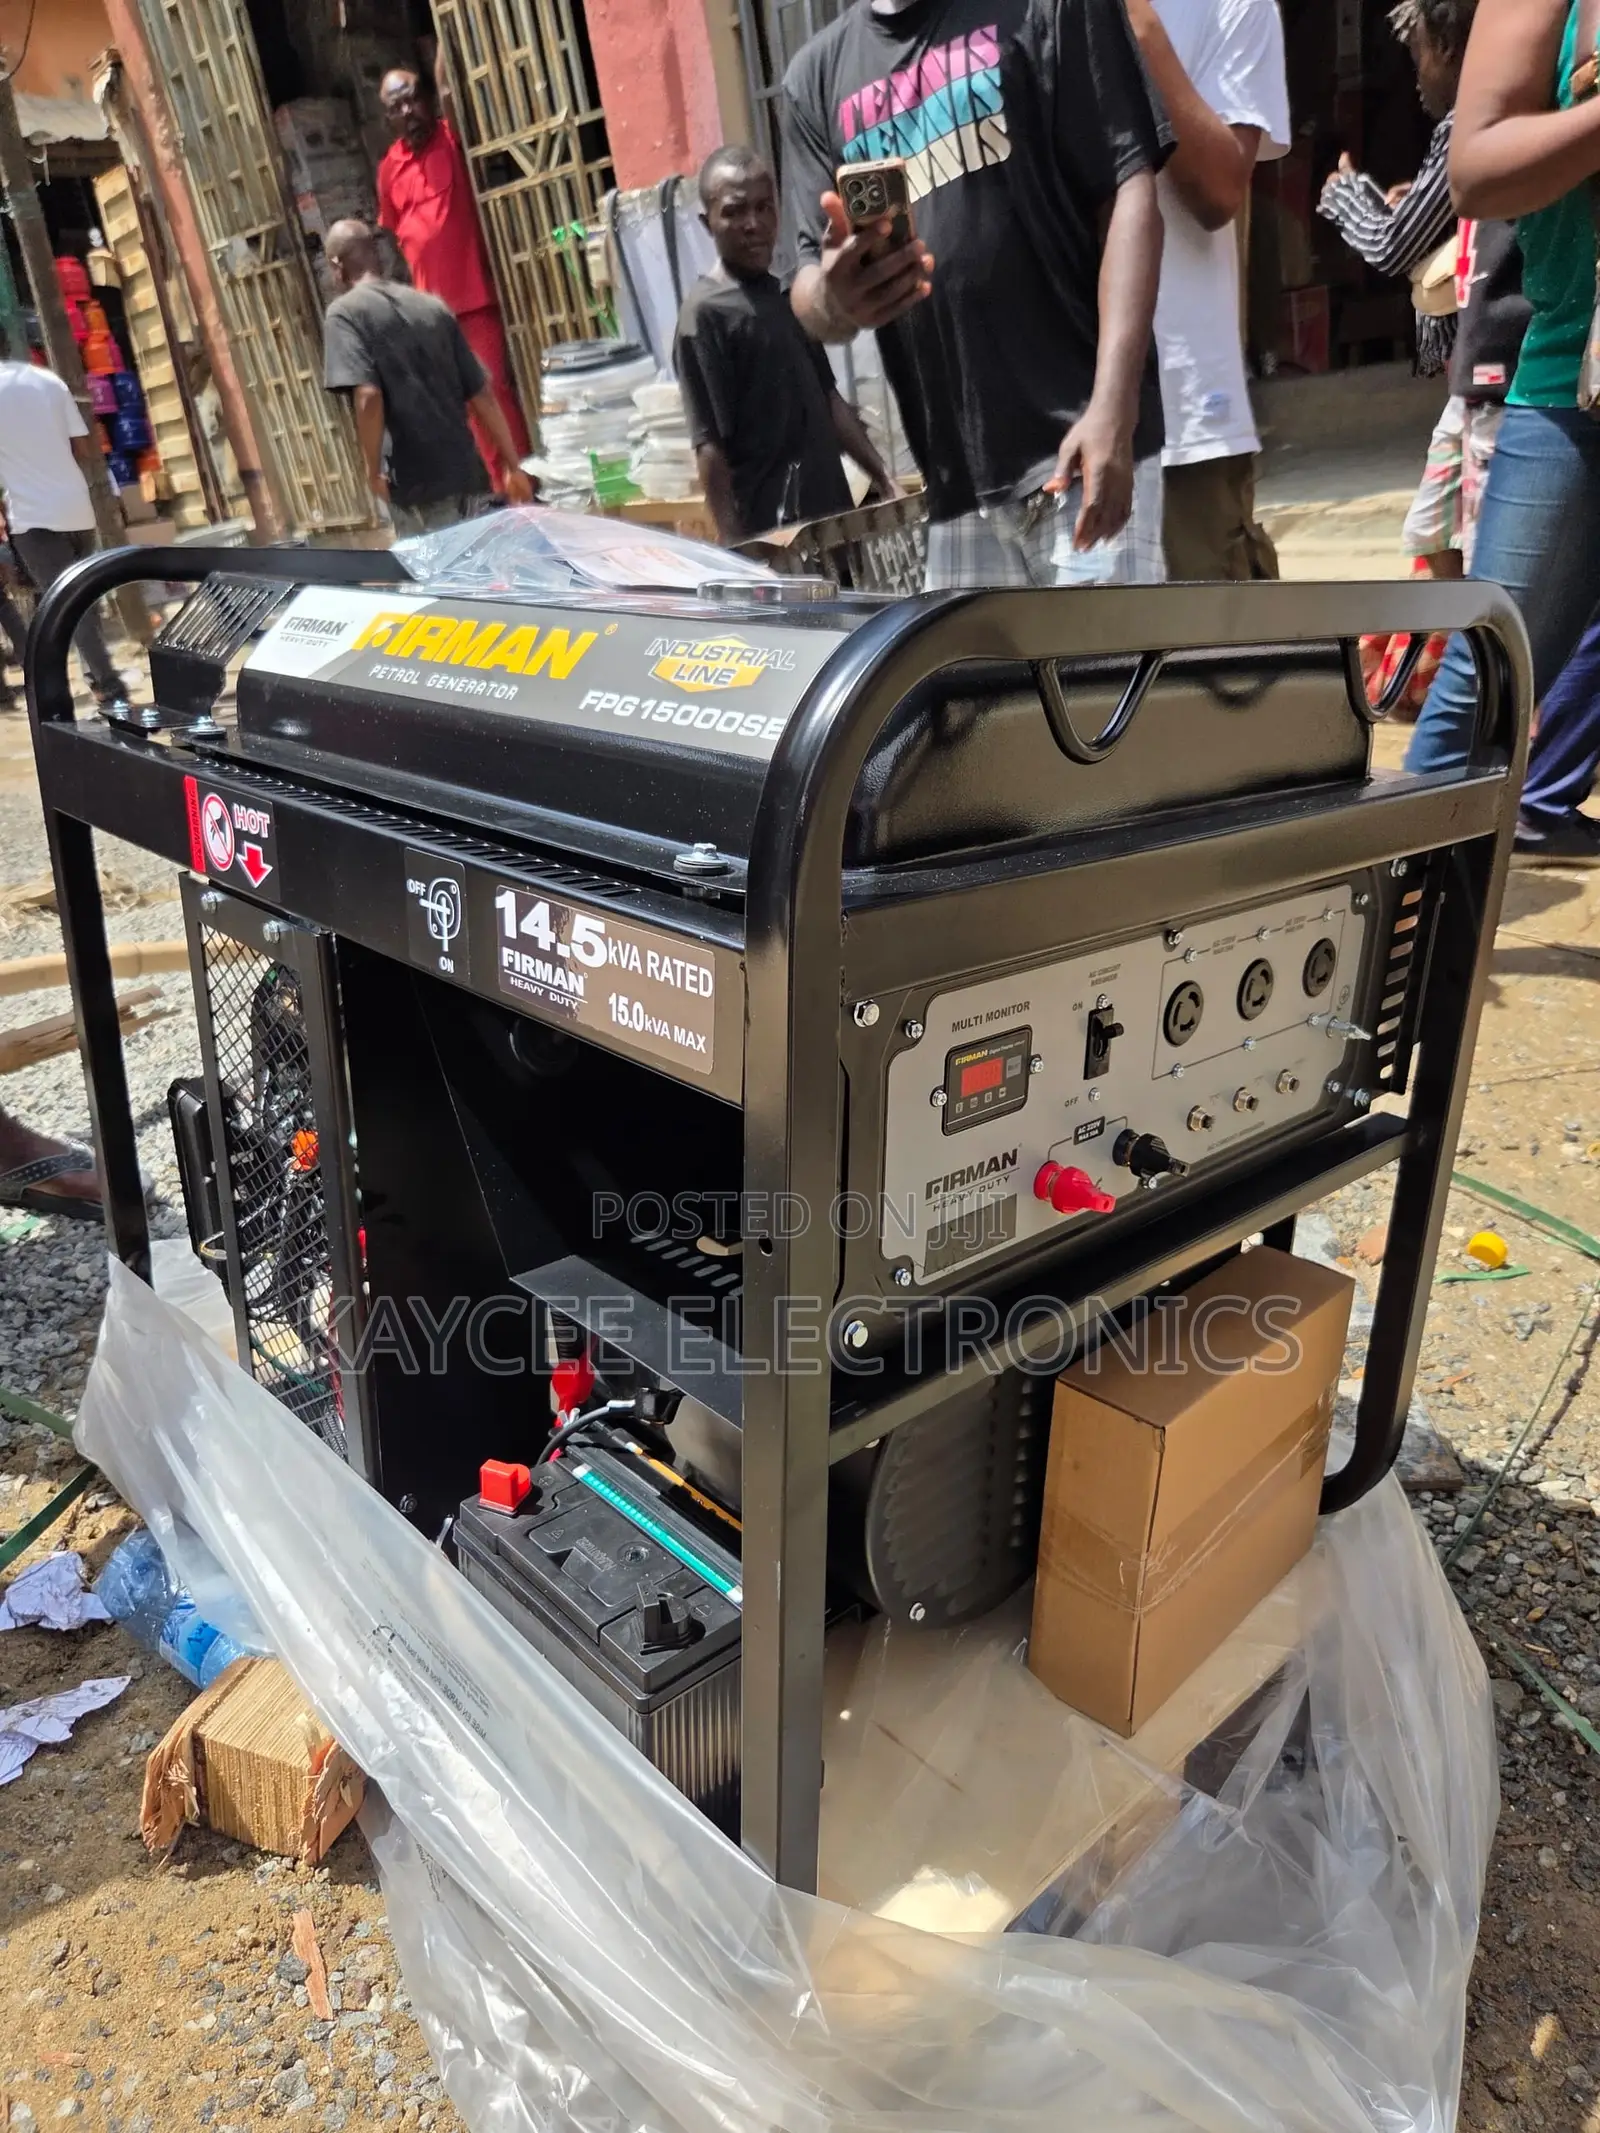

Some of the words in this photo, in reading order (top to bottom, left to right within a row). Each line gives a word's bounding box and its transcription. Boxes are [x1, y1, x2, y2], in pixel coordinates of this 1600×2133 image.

[283, 616, 349, 637] FIRMAN
[351, 611, 599, 681] FIRMAN
[644, 637, 796, 671] INDUSTRIAL
[368, 664, 421, 686] PETROL
[426, 673, 519, 701] GENERATOR
[672, 662, 737, 687] LINE
[231, 803, 270, 838] HOT
[406, 878, 426, 896] OFF
[439, 956, 454, 973] ON
[502, 947, 585, 997] FIRMAN
[607, 937, 643, 974] kVA
[647, 950, 714, 998] RATED
[510, 976, 544, 997] HEAVY
[549, 990, 578, 1010] DUTY
[1072, 1001, 1083, 1011] ON
[608, 992, 644, 1033] 15.0
[644, 1013, 671, 1040] kVA
[673, 1026, 707, 1054] MAX
[951, 1016, 983, 1033] MULTI
[985, 1001, 1031, 1023] MONITOR
[955, 1049, 988, 1066] FIRMAN
[1064, 1096, 1079, 1108] OFF
[925, 1148, 1018, 1201] FIRMAN
[933, 1189, 975, 1212] HEAVY
[979, 1175, 1010, 1192] DUTY
